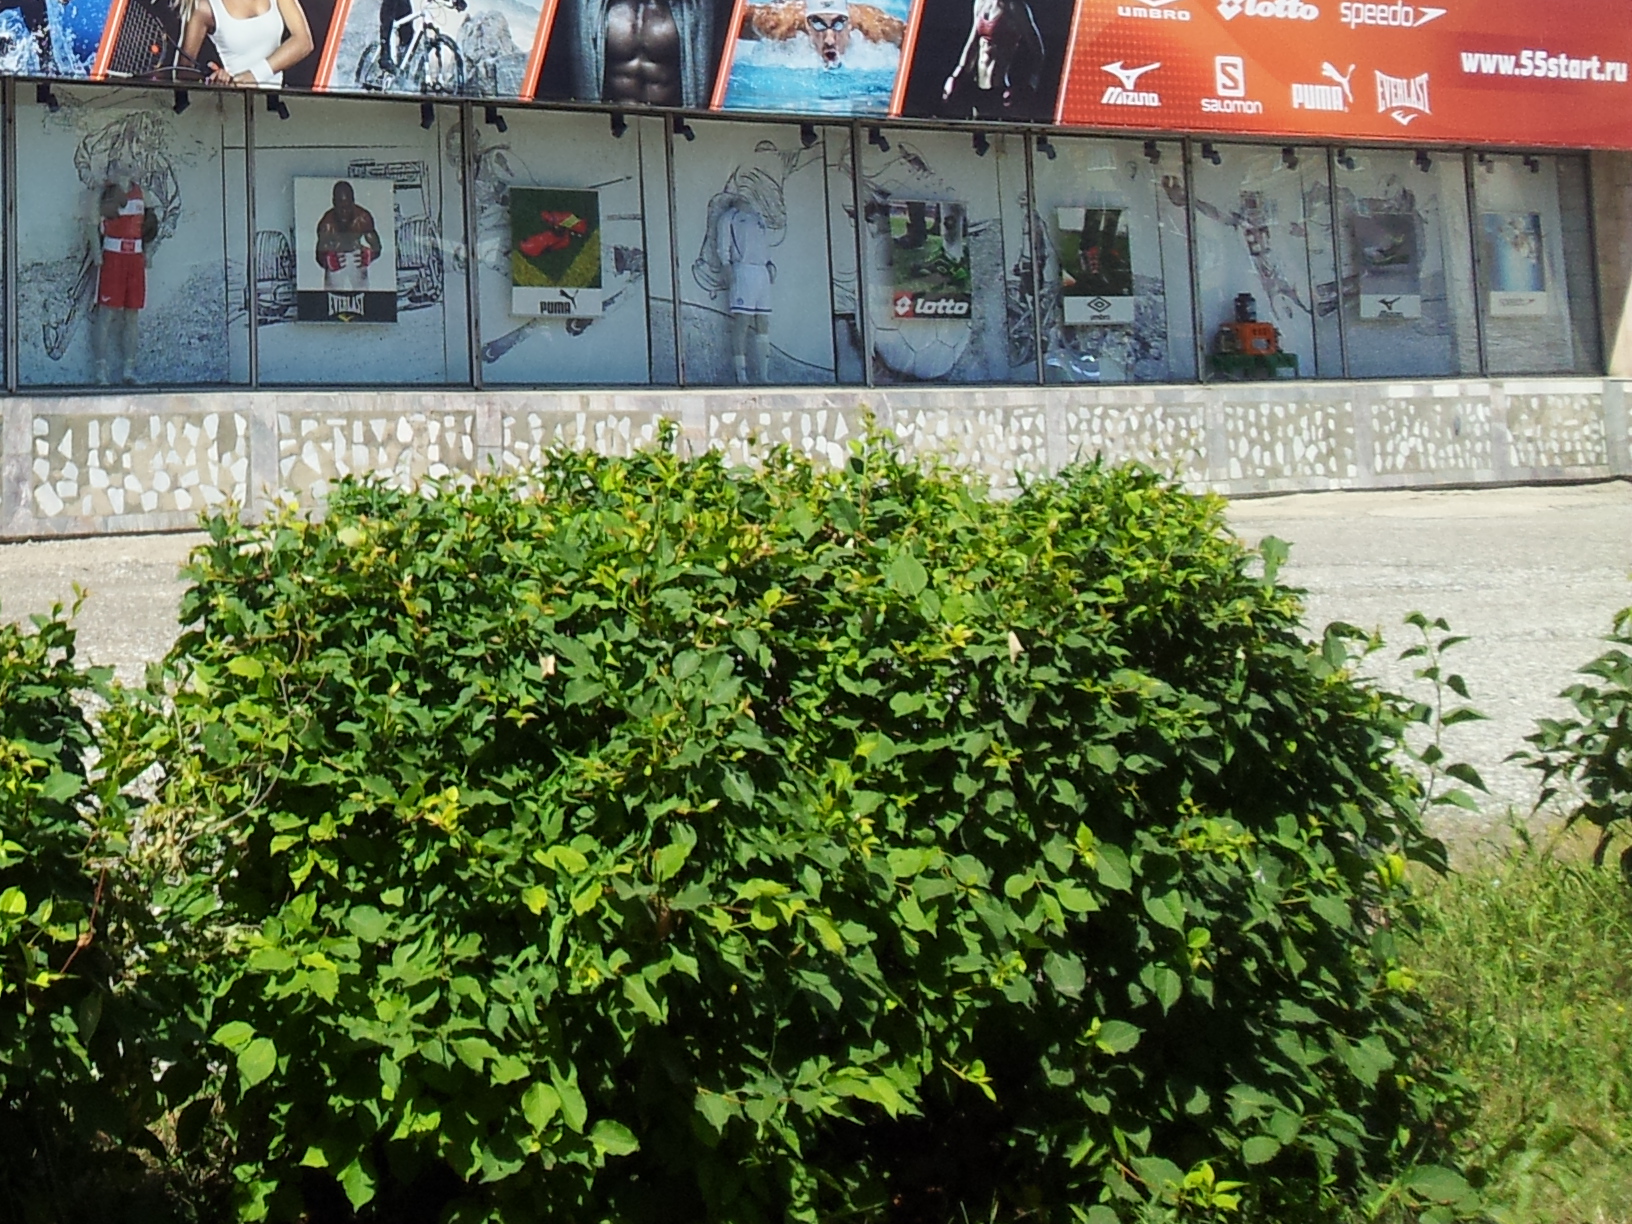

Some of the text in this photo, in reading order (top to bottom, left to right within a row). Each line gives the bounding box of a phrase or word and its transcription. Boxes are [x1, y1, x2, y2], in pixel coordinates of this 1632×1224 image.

[1117, 6, 1191, 22] UMBRO
[1339, 0, 1415, 30] speedo
[1460, 49, 1629, 83] www.55start.ru
[1290, 83, 1344, 111] PUMA
[1374, 69, 1433, 115] EVERLAST
[328, 292, 365, 316] EVERLAST
[539, 301, 571, 314] PUMA
